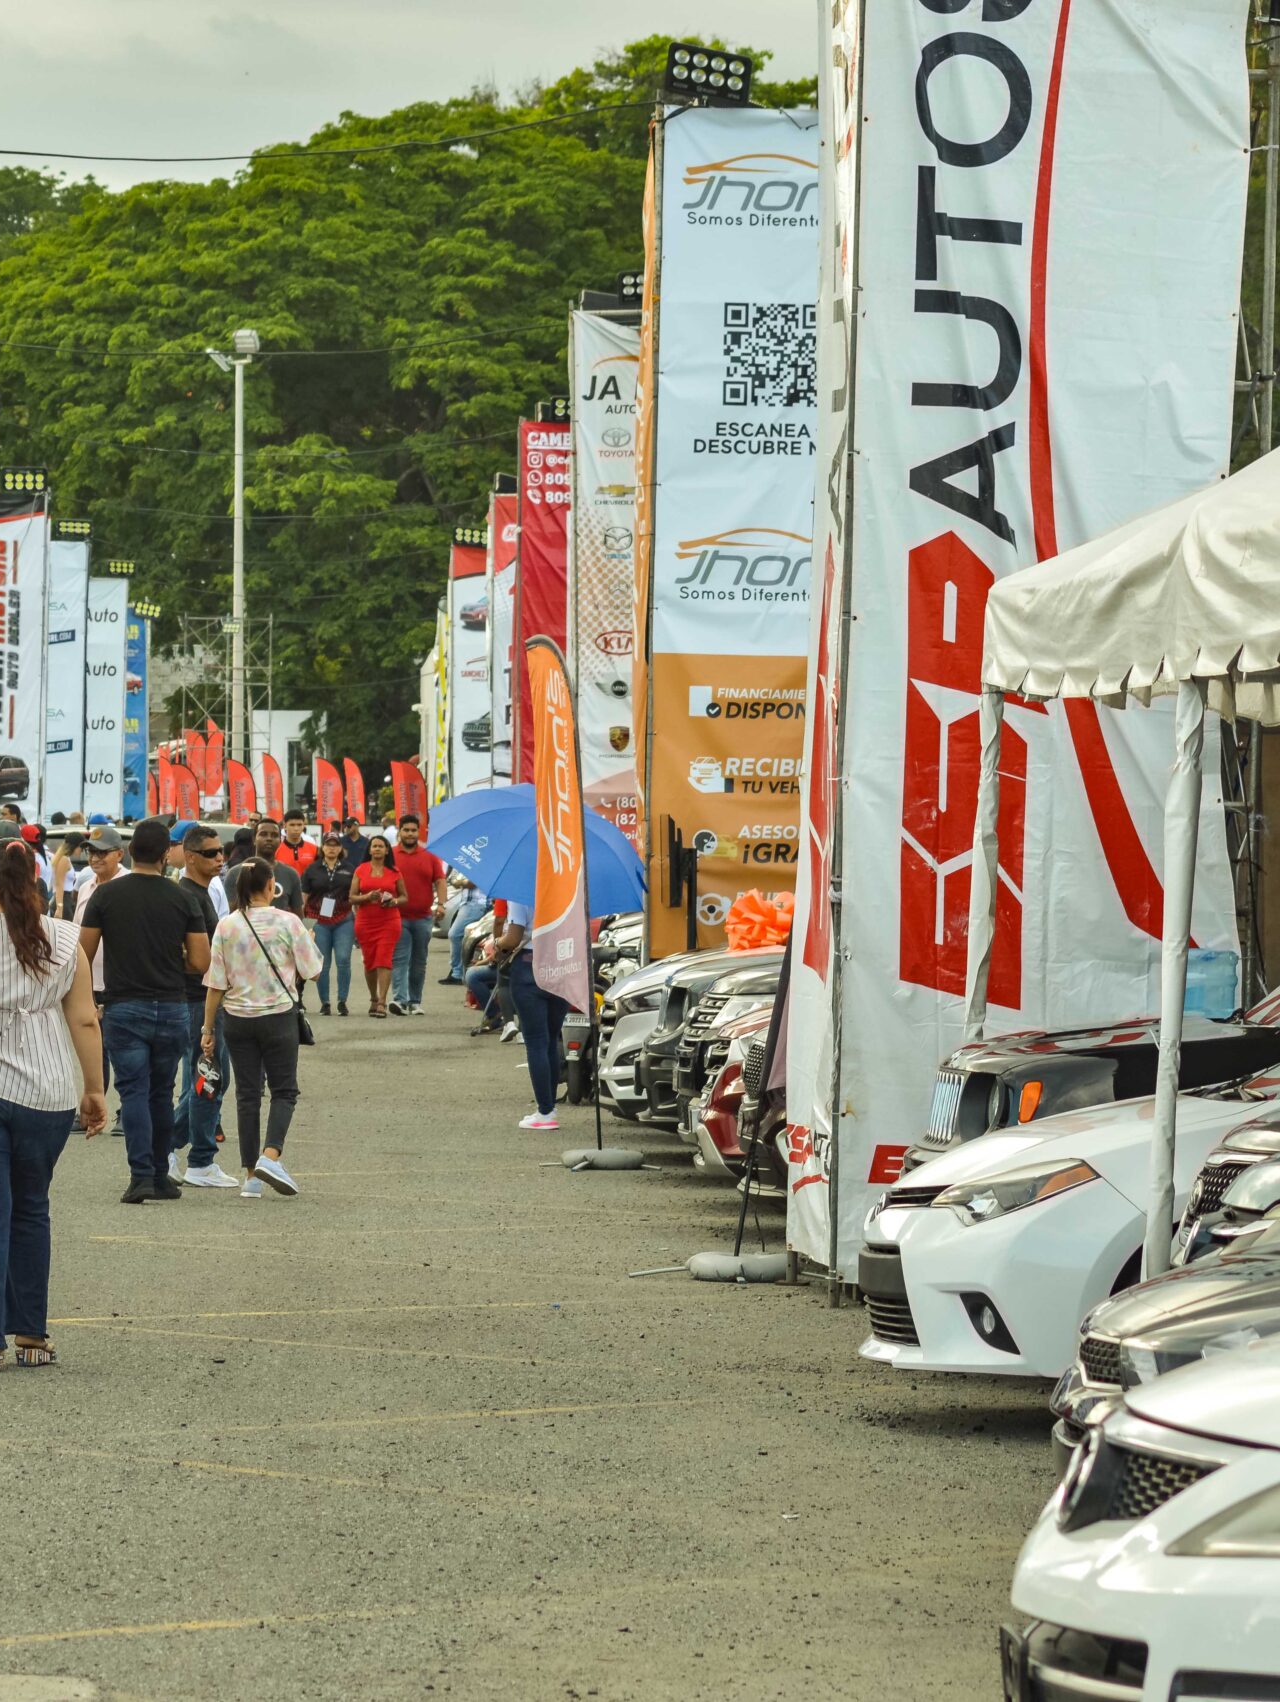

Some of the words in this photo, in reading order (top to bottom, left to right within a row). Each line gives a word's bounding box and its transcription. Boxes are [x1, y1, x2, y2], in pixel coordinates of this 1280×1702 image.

[686, 211, 744, 226] Somos
[715, 421, 811, 438] ESCANEA
[692, 438, 803, 456] DESCUBRE
[679, 586, 735, 601] Somos
[742, 781, 763, 794] TU
